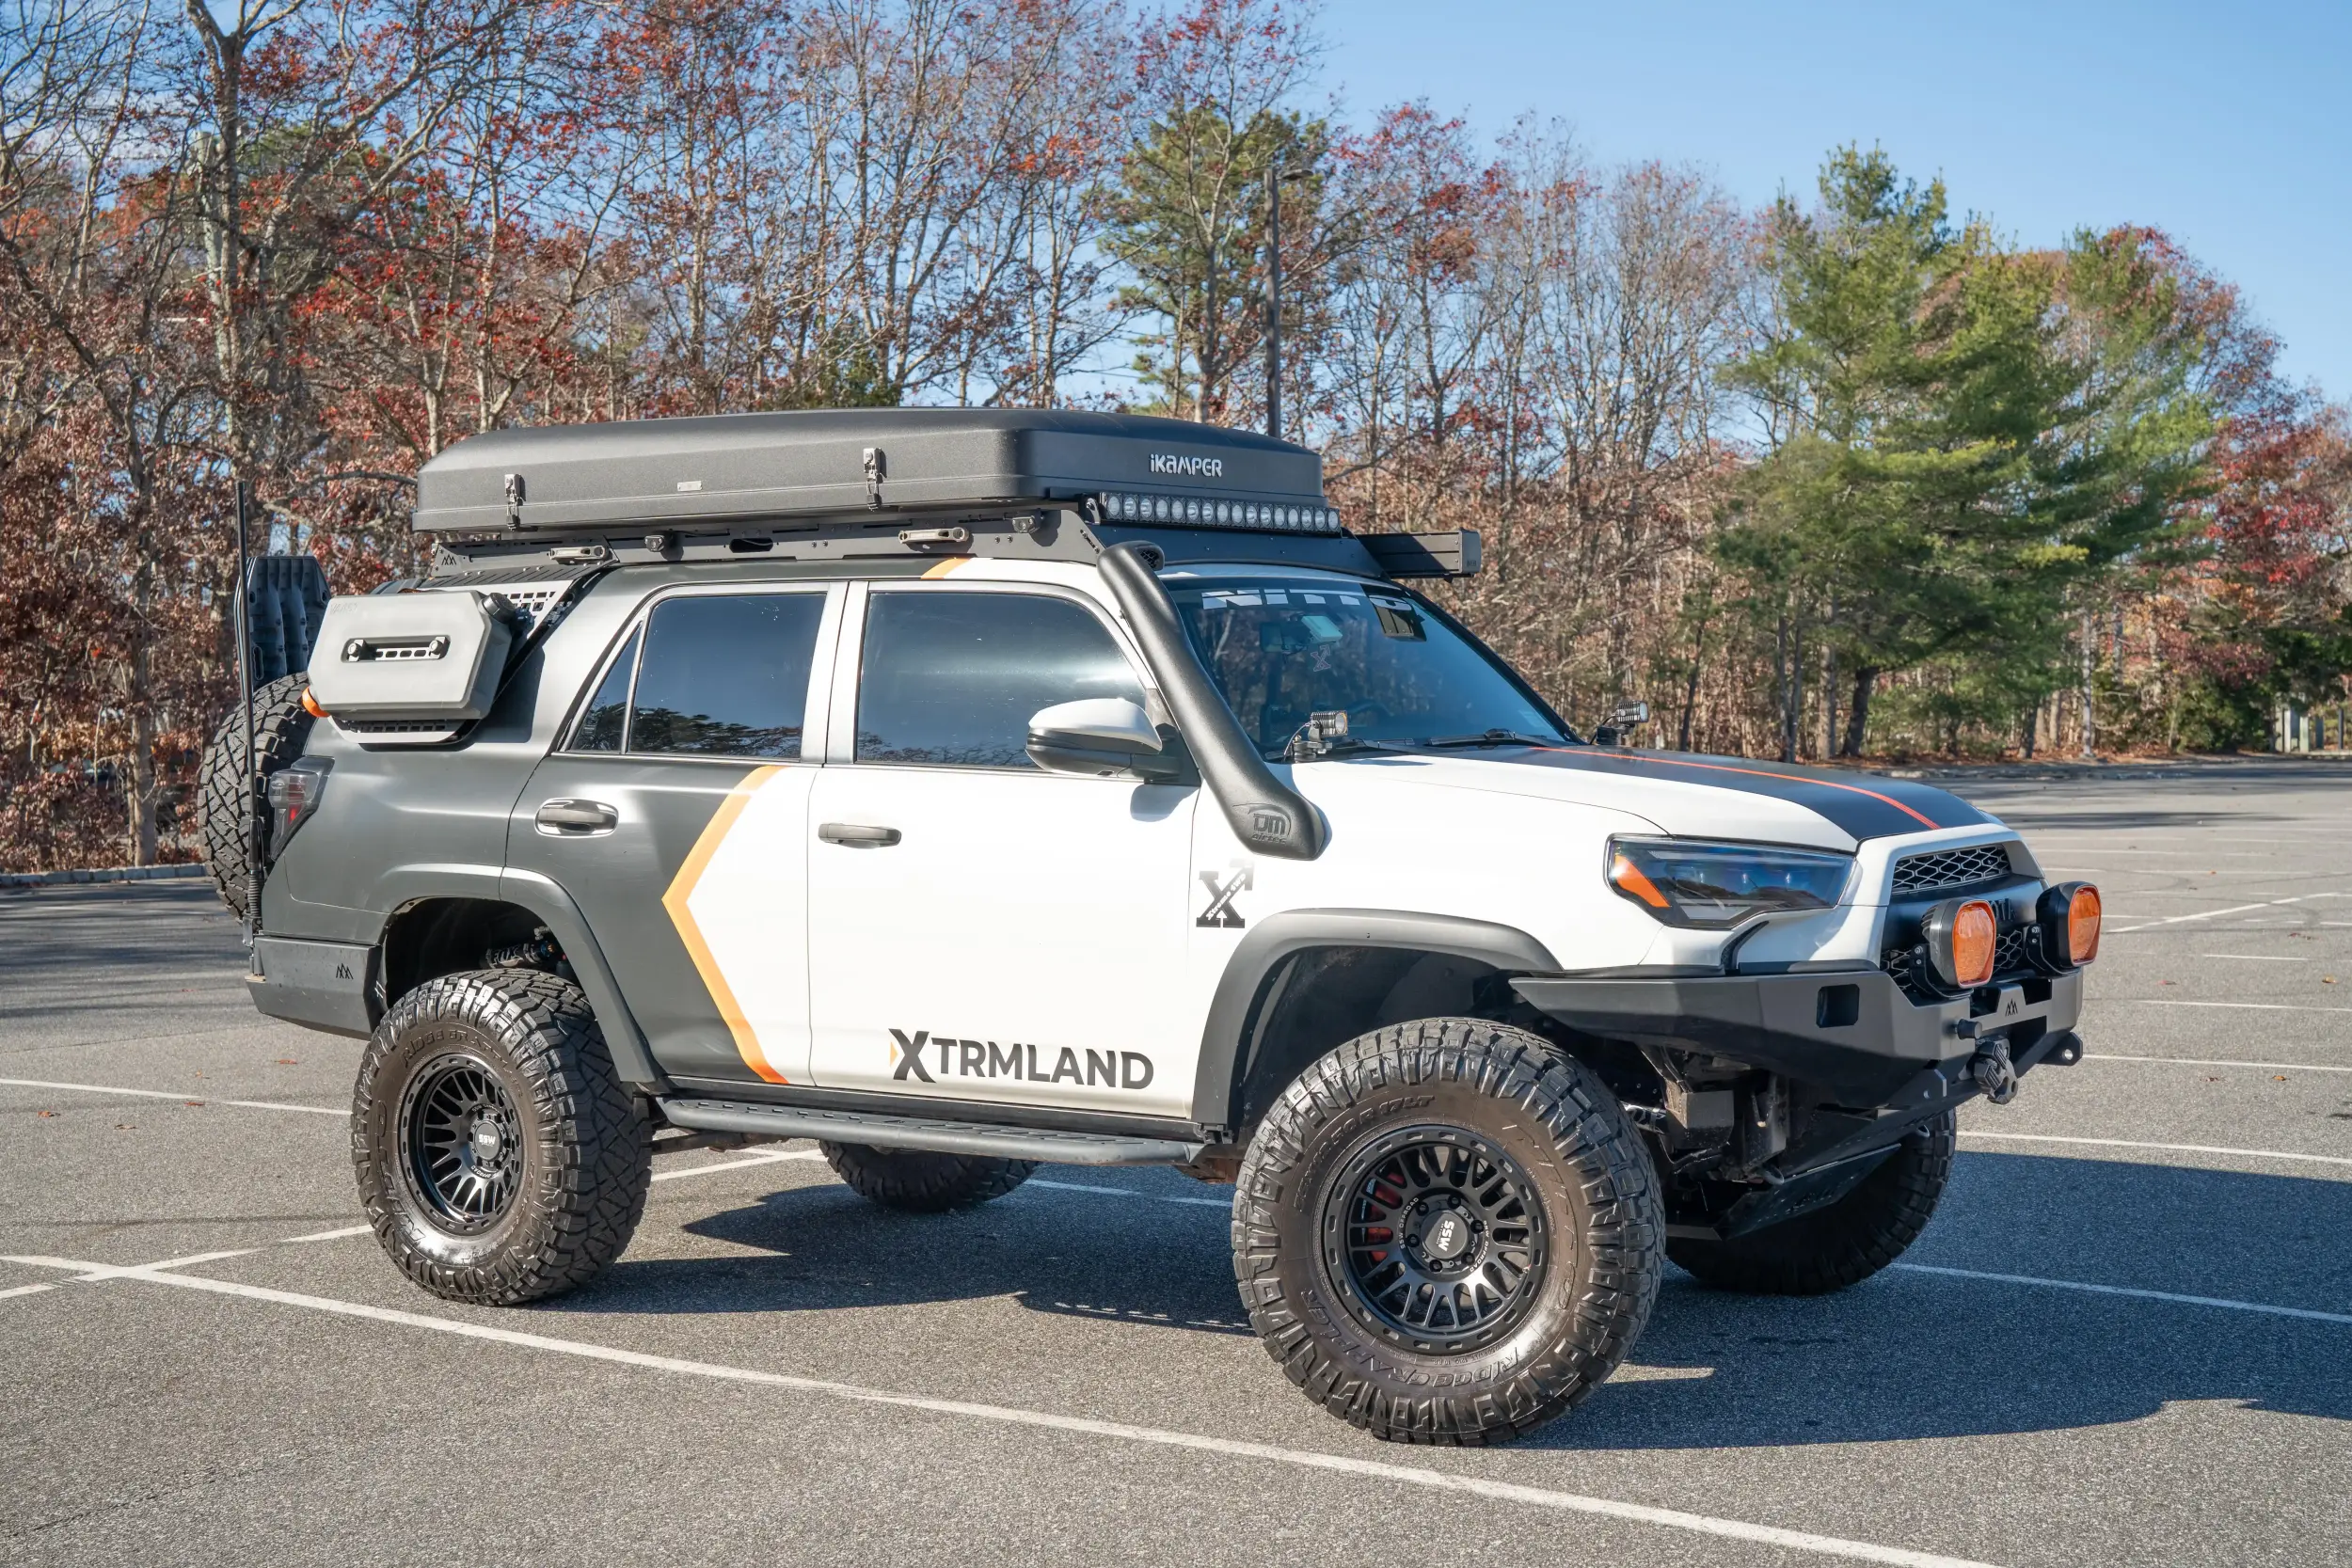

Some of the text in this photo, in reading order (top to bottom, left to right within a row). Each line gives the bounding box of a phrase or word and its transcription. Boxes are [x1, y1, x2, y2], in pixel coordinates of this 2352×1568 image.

[1253, 813, 1286, 836] TJM
[889, 1027, 1154, 1090] XTRMLAND
[1438, 1220, 1455, 1252] SSW
[1432, 1346, 1520, 1387] RIDGE
